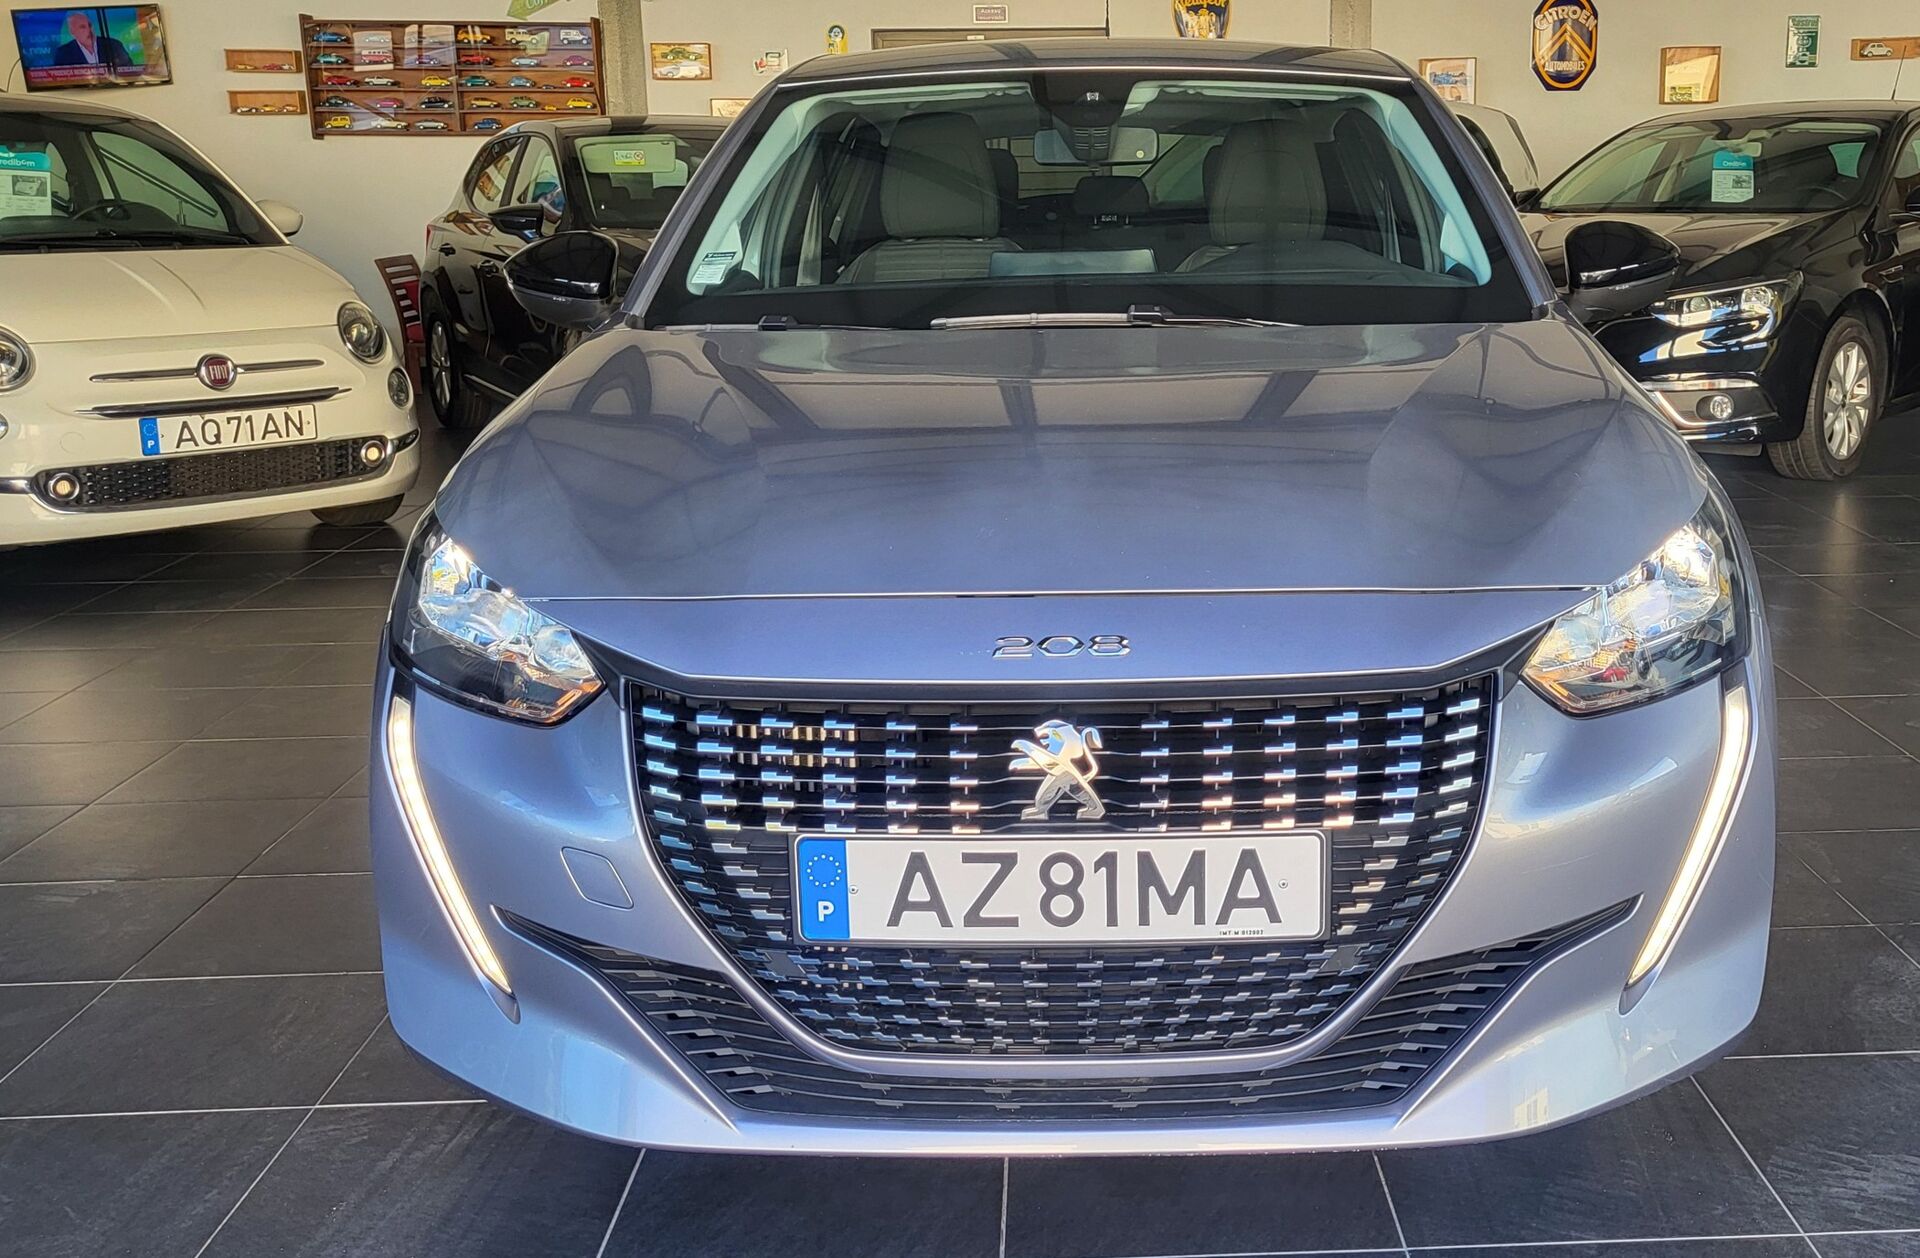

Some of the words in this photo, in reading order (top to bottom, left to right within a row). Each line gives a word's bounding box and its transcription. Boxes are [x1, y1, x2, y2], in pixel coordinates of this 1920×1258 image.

[1544, 61, 1585, 71] AUTOMOBILES
[208, 364, 228, 380] FIAT
[147, 440, 155, 449] P
[992, 634, 1131, 659] 208
[817, 900, 835, 922] P
